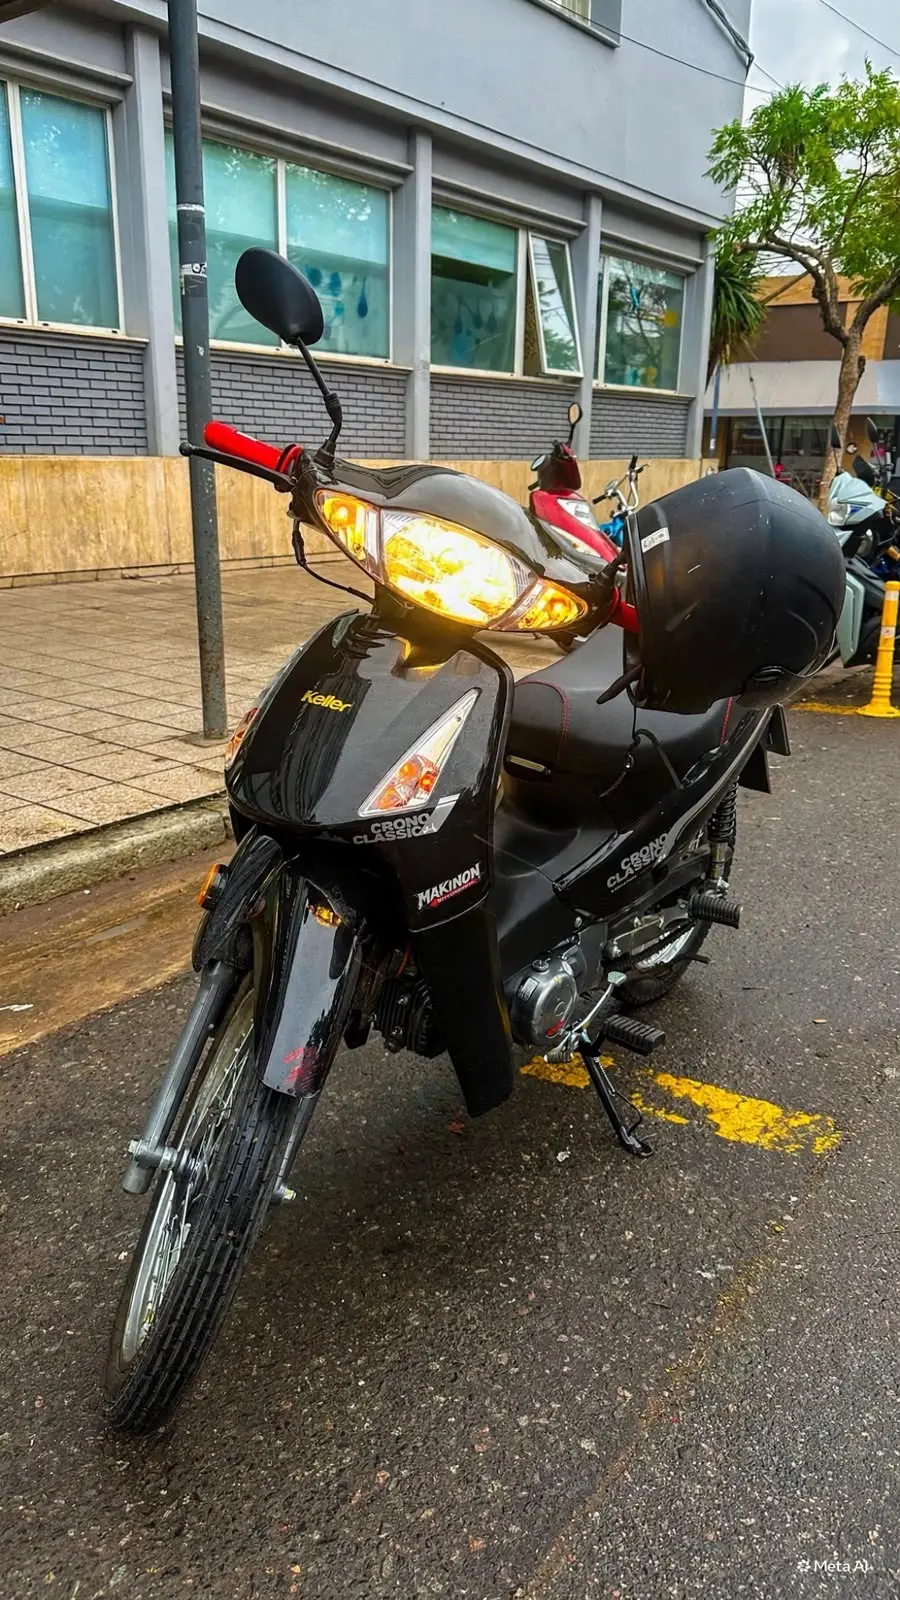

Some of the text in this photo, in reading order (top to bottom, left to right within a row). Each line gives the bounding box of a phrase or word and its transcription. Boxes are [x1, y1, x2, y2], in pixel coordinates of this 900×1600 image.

[301, 690, 352, 712] Keller
[353, 826, 425, 845] CLASSIC
[371, 813, 430, 834] CRONO
[620, 833, 669, 871] CRONO
[606, 847, 663, 889] CLASSIC
[416, 862, 481, 911] MAKINON
